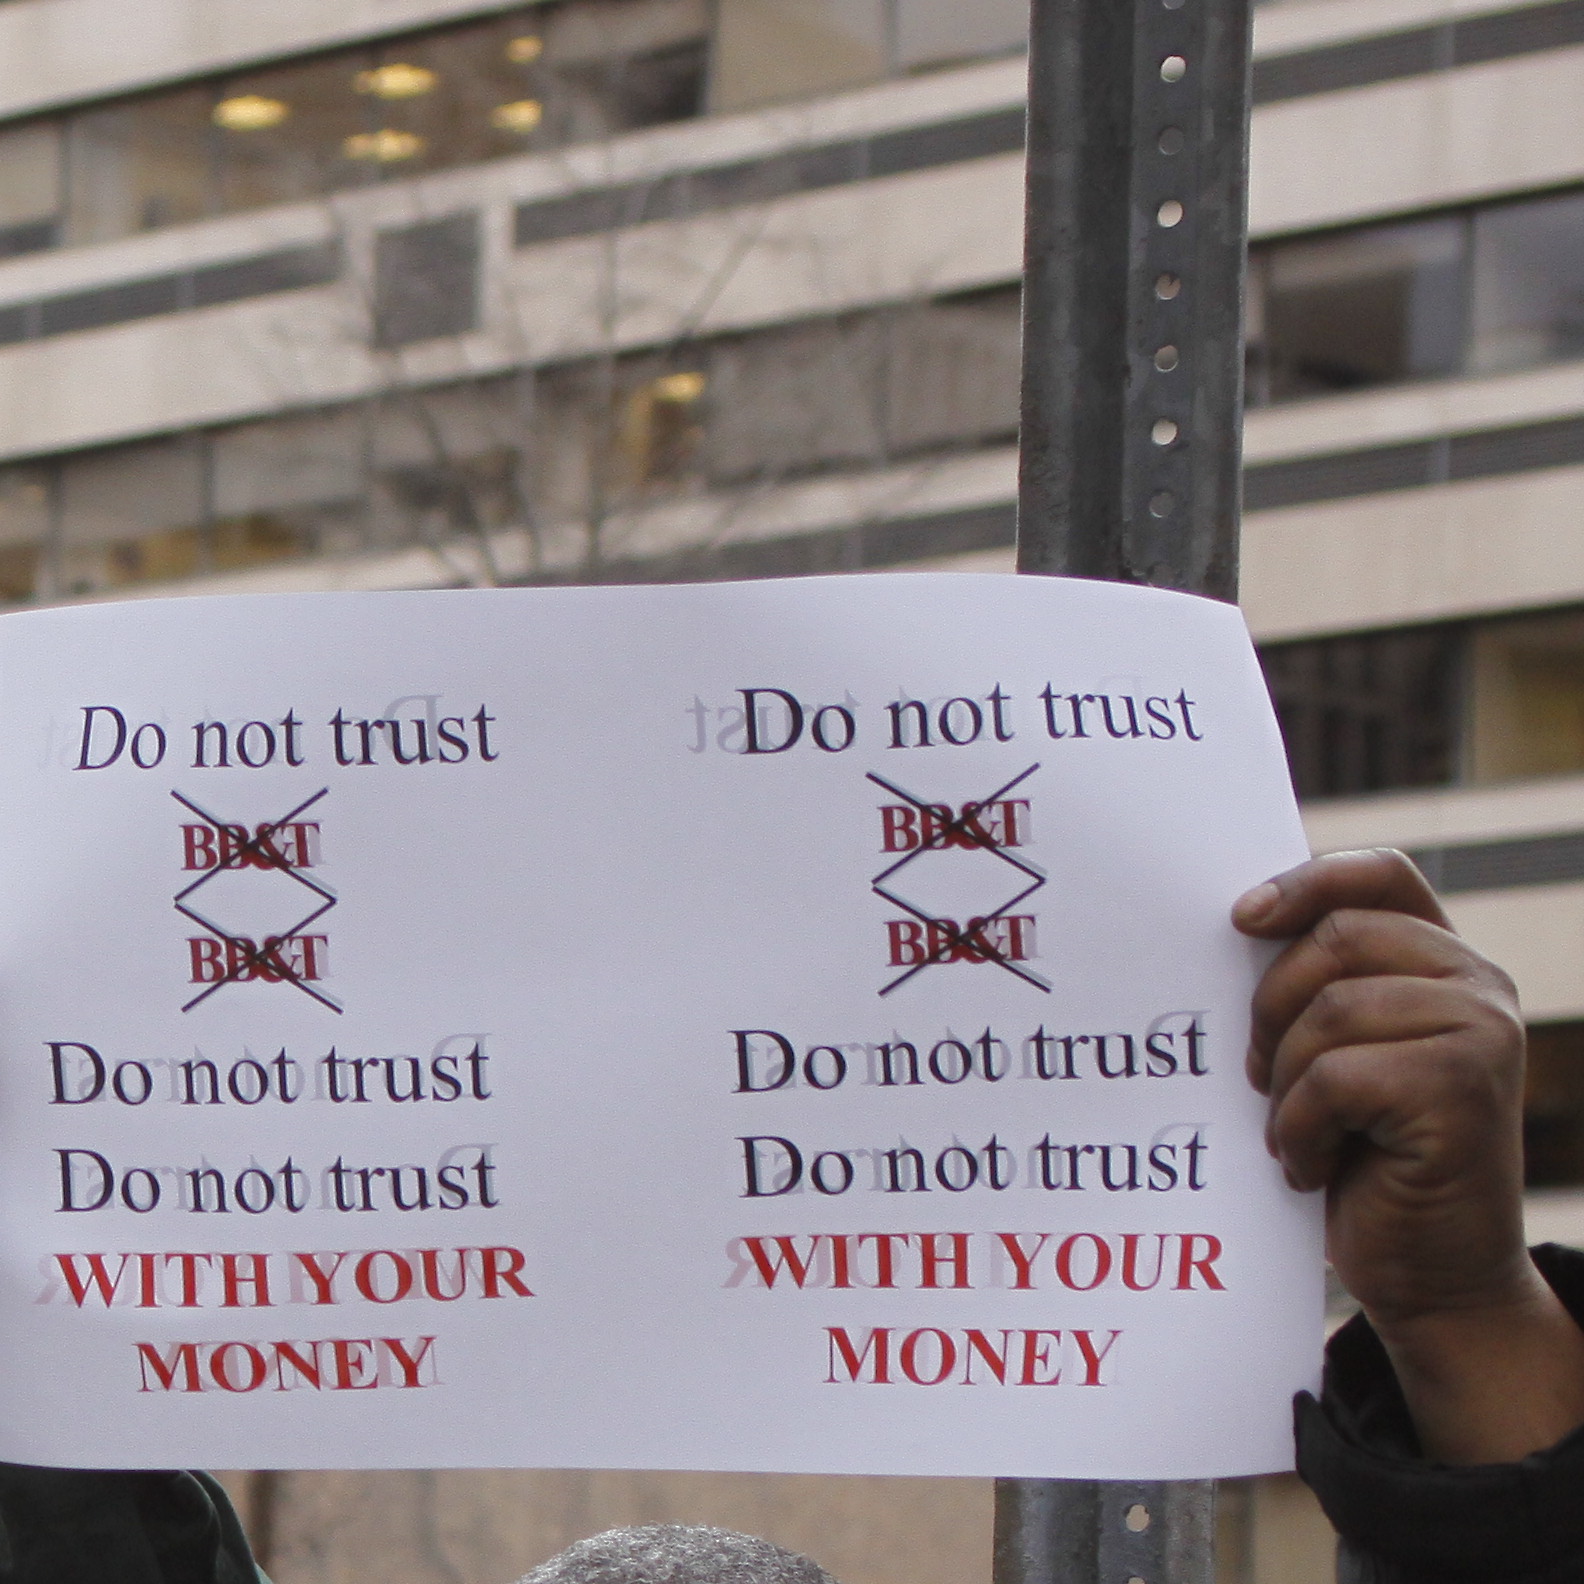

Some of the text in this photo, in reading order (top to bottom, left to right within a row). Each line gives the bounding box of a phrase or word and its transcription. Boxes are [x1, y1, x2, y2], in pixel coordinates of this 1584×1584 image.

[76, 704, 498, 770] Do not trust
[739, 682, 1202, 755] Do not trust
[181, 821, 318, 872] BB&T
[881, 798, 1030, 852] BB&T
[188, 935, 327, 984] BB&T
[886, 913, 1037, 967] BB&T
[47, 1042, 491, 1106] Do not trust
[732, 1019, 1208, 1093] Do not trust
[55, 1148, 498, 1214] Do not trust
[738, 1132, 1208, 1198] Do not trust
[57, 1247, 532, 1308] WITH YOUR
[744, 1233, 1223, 1291] WITH YOUR
[138, 1337, 433, 1392] MONEY
[824, 1328, 1121, 1388] MONEY
